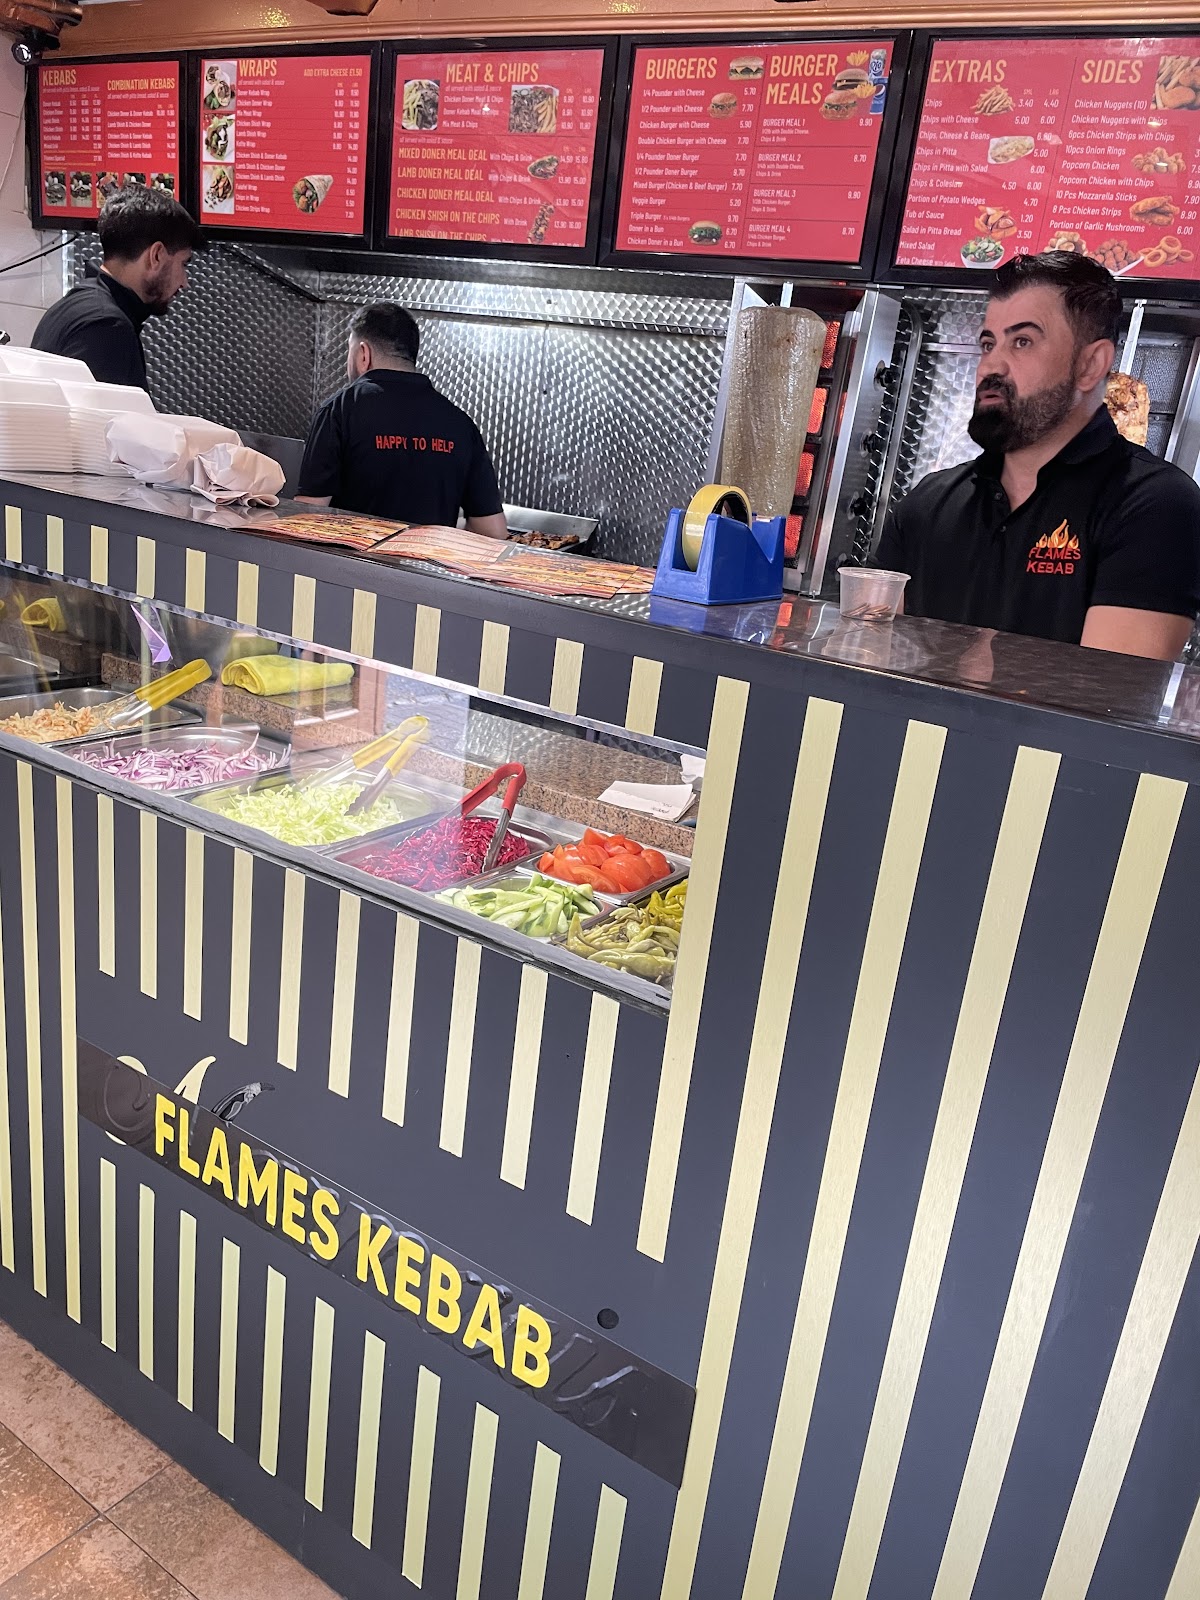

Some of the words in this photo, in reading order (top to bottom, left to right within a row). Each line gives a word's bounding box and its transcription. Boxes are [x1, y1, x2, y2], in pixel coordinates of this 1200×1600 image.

[239, 60, 277, 77] WRAPS
[646, 57, 717, 80] BURGERS
[769, 54, 839, 77] BURGER
[930, 59, 1007, 83] EXTRAS
[1081, 59, 1143, 83] SIDES
[43, 69, 77, 86] KEBABS
[446, 63, 480, 83] MEAT
[484, 64, 494, 83] &
[499, 63, 539, 83] CHIPS
[107, 79, 149, 91] COMBINATION
[150, 78, 175, 90] KEBABS
[674, 88, 685, 96] with
[686, 88, 705, 96] Cheese
[744, 87, 756, 96] 5.70
[765, 82, 823, 105] MEALS
[925, 99, 943, 109] Chips
[1018, 99, 1033, 107] 3.40
[1044, 98, 1059, 108] 4.40
[1074, 100, 1102, 108] Chicken
[1104, 100, 1132, 110] Nuggets
[1134, 100, 1148, 110] (10)
[660, 121, 677, 130] Burger
[691, 121, 709, 129] Cheese
[740, 120, 752, 128] 5.90
[763, 118, 785, 127] BURGER
[786, 118, 801, 126] MEAL
[802, 118, 806, 126] 1
[859, 118, 872, 126] 9.90
[922, 115, 939, 125] Chips
[941, 115, 954, 123] with
[956, 115, 979, 124] Cheese
[1014, 116, 1030, 124] 5.00
[1040, 115, 1056, 124] 6.00
[1071, 115, 1099, 124] Chicken
[1100, 115, 1129, 126] Nuggets
[1131, 116, 1146, 124] with
[638, 137, 654, 145] Double
[655, 137, 675, 145] Chicken
[677, 137, 694, 146] Burger
[708, 137, 726, 145] Cheese
[738, 137, 749, 145] 7.70
[1068, 130, 1084, 140] 6pcs
[1086, 130, 1114, 139] Chicken
[1116, 131, 1137, 141] Strips
[1138, 132, 1153, 140] with
[1155, 132, 1175, 142] Chips
[399, 148, 420, 159] MIXED
[421, 148, 446, 160] DONER
[447, 149, 467, 160] MEAL
[469, 149, 487, 161] DEAL
[916, 147, 933, 157] Chips
[935, 147, 941, 155] in
[942, 147, 957, 155] Pitta
[1033, 149, 1048, 157] 5.00
[1066, 145, 1084, 155] 10pcs
[1086, 145, 1105, 154] Onion
[1107, 146, 1126, 155] Rings
[913, 163, 930, 172] Chips
[932, 163, 938, 171] in
[939, 163, 954, 171] Pitta
[956, 164, 969, 172] with
[970, 164, 988, 173] Salad
[1030, 165, 1045, 174] 6.00
[1062, 160, 1090, 171] Popcorn
[1091, 161, 1120, 170] Chicken
[398, 167, 417, 178] LAMB
[418, 167, 442, 179] DONER
[444, 168, 463, 180] MEAL
[465, 169, 483, 181] DEAL
[910, 179, 928, 188] Chips
[929, 179, 934, 188] &
[1002, 182, 1016, 190] 4.50
[1059, 175, 1087, 185] Popcorn
[1088, 176, 1116, 186] Chicken
[1118, 177, 1133, 185] with
[1134, 177, 1154, 188] Chips
[397, 187, 427, 199] CHICKEN
[429, 188, 453, 200] DONER
[454, 189, 474, 202] MEAL
[475, 190, 494, 203] DEAL
[632, 197, 648, 206] Veggie
[650, 198, 666, 206] Burger
[1056, 190, 1062, 199] 10
[1064, 190, 1076, 199] Pcs
[1078, 191, 1114, 200] Mozzarella
[1115, 192, 1137, 201] Sticks
[1184, 195, 1200, 204] 7.90
[396, 208, 426, 220] CHICKEN
[427, 210, 448, 221] SHISH
[450, 211, 460, 222] ON
[462, 212, 476, 223] THE
[478, 213, 500, 224] CHIPS
[905, 210, 917, 218] Tub
[918, 210, 924, 218] of
[926, 211, 944, 219] Sauce
[1020, 214, 1033, 223] 1.20
[1053, 205, 1057, 213] 8
[1059, 205, 1070, 214] Pcs
[1072, 206, 1100, 215] Chicken
[1101, 207, 1122, 217] Strips
[1180, 211, 1197, 219] 8.90
[902, 226, 919, 234] Salad
[920, 226, 926, 234] in
[927, 226, 942, 235] Pitta
[943, 227, 962, 236] Bread
[1017, 230, 1032, 239] 3.50
[1050, 220, 1074, 229] Portion
[1075, 221, 1083, 230] of
[1084, 221, 1104, 231] Garlic
[1105, 222, 1145, 233] Mushrooms
[1176, 226, 1193, 235] 6.00
[628, 237, 647, 245] Chicken
[648, 238, 663, 246] Doner
[376, 435, 407, 449] HAPPY
[412, 438, 426, 450] TO
[432, 438, 454, 453] HELP
[1029, 547, 1081, 560] FLAMES
[1026, 560, 1074, 574] KEBAB
[153, 1092, 342, 1262] FLAMES
[356, 1212, 552, 1390] KEBAB
